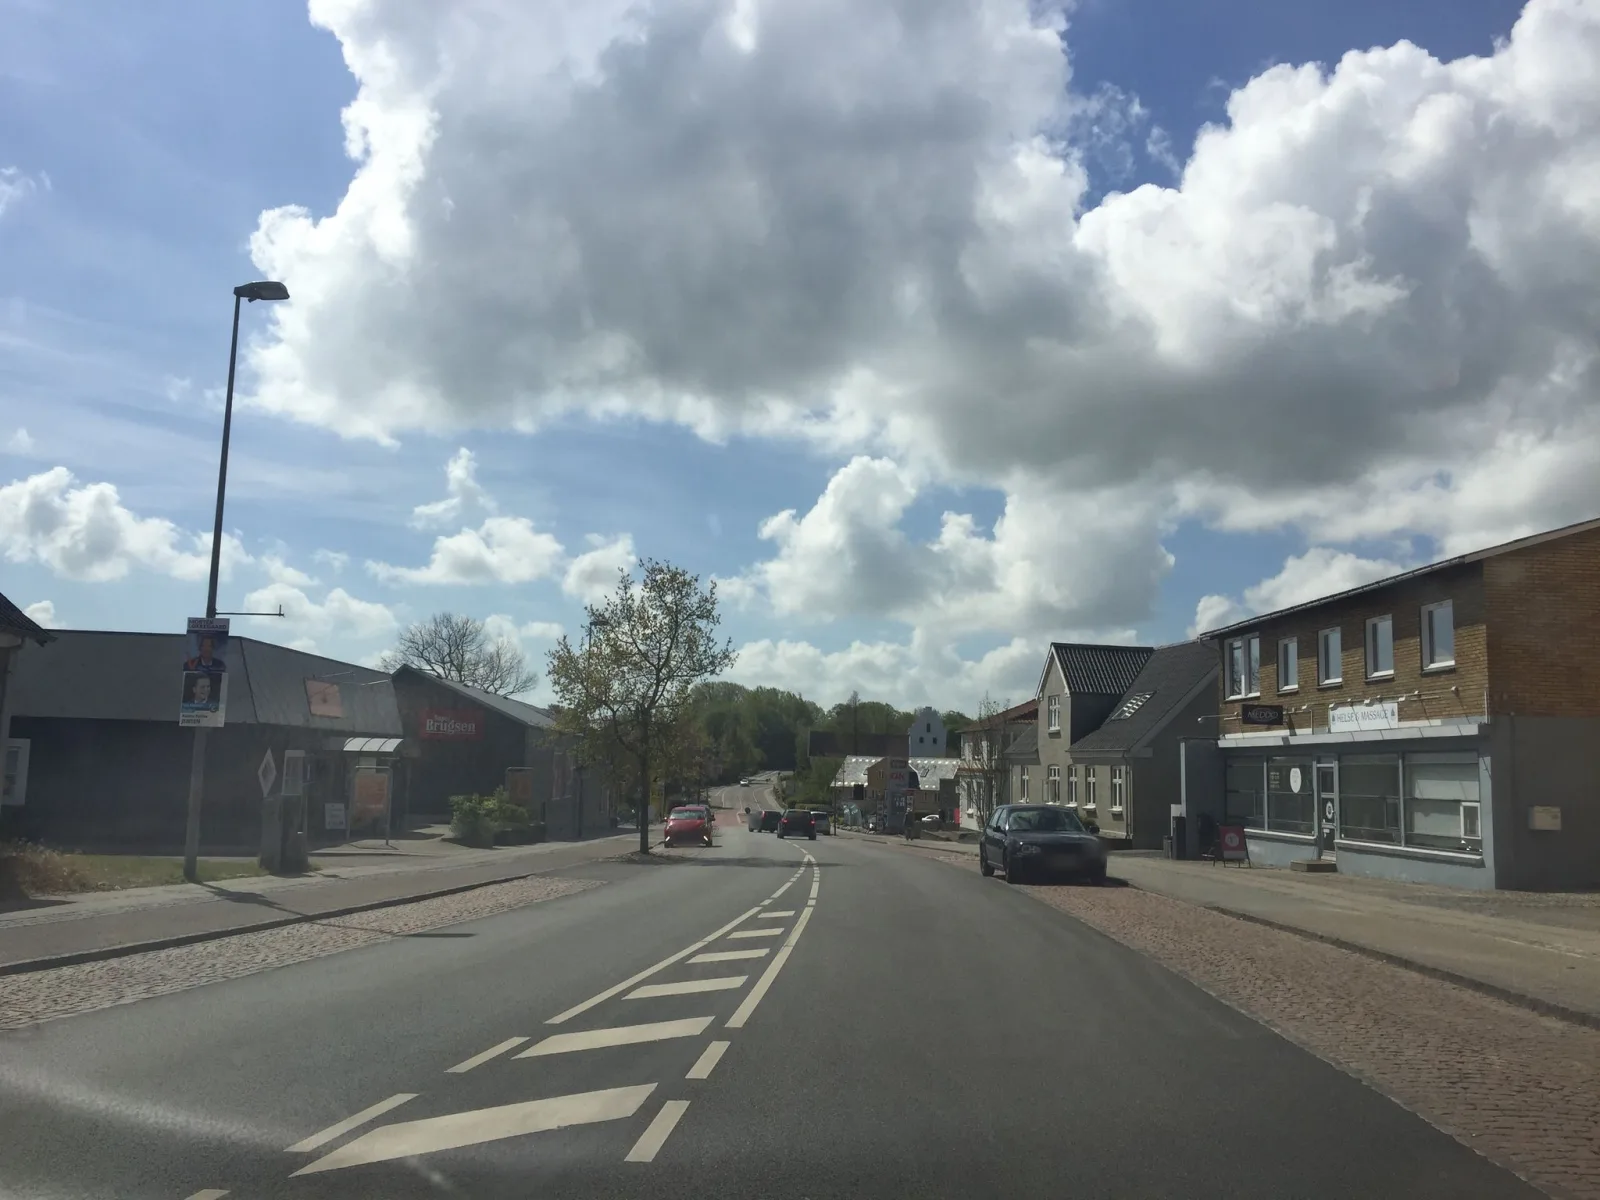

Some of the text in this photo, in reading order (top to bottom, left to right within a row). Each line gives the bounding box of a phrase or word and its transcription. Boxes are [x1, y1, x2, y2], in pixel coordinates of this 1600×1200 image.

[1336, 713, 1354, 723] HELSE
[1361, 709, 1389, 720] MASSAGE
[426, 718, 476, 734] Brugsen
